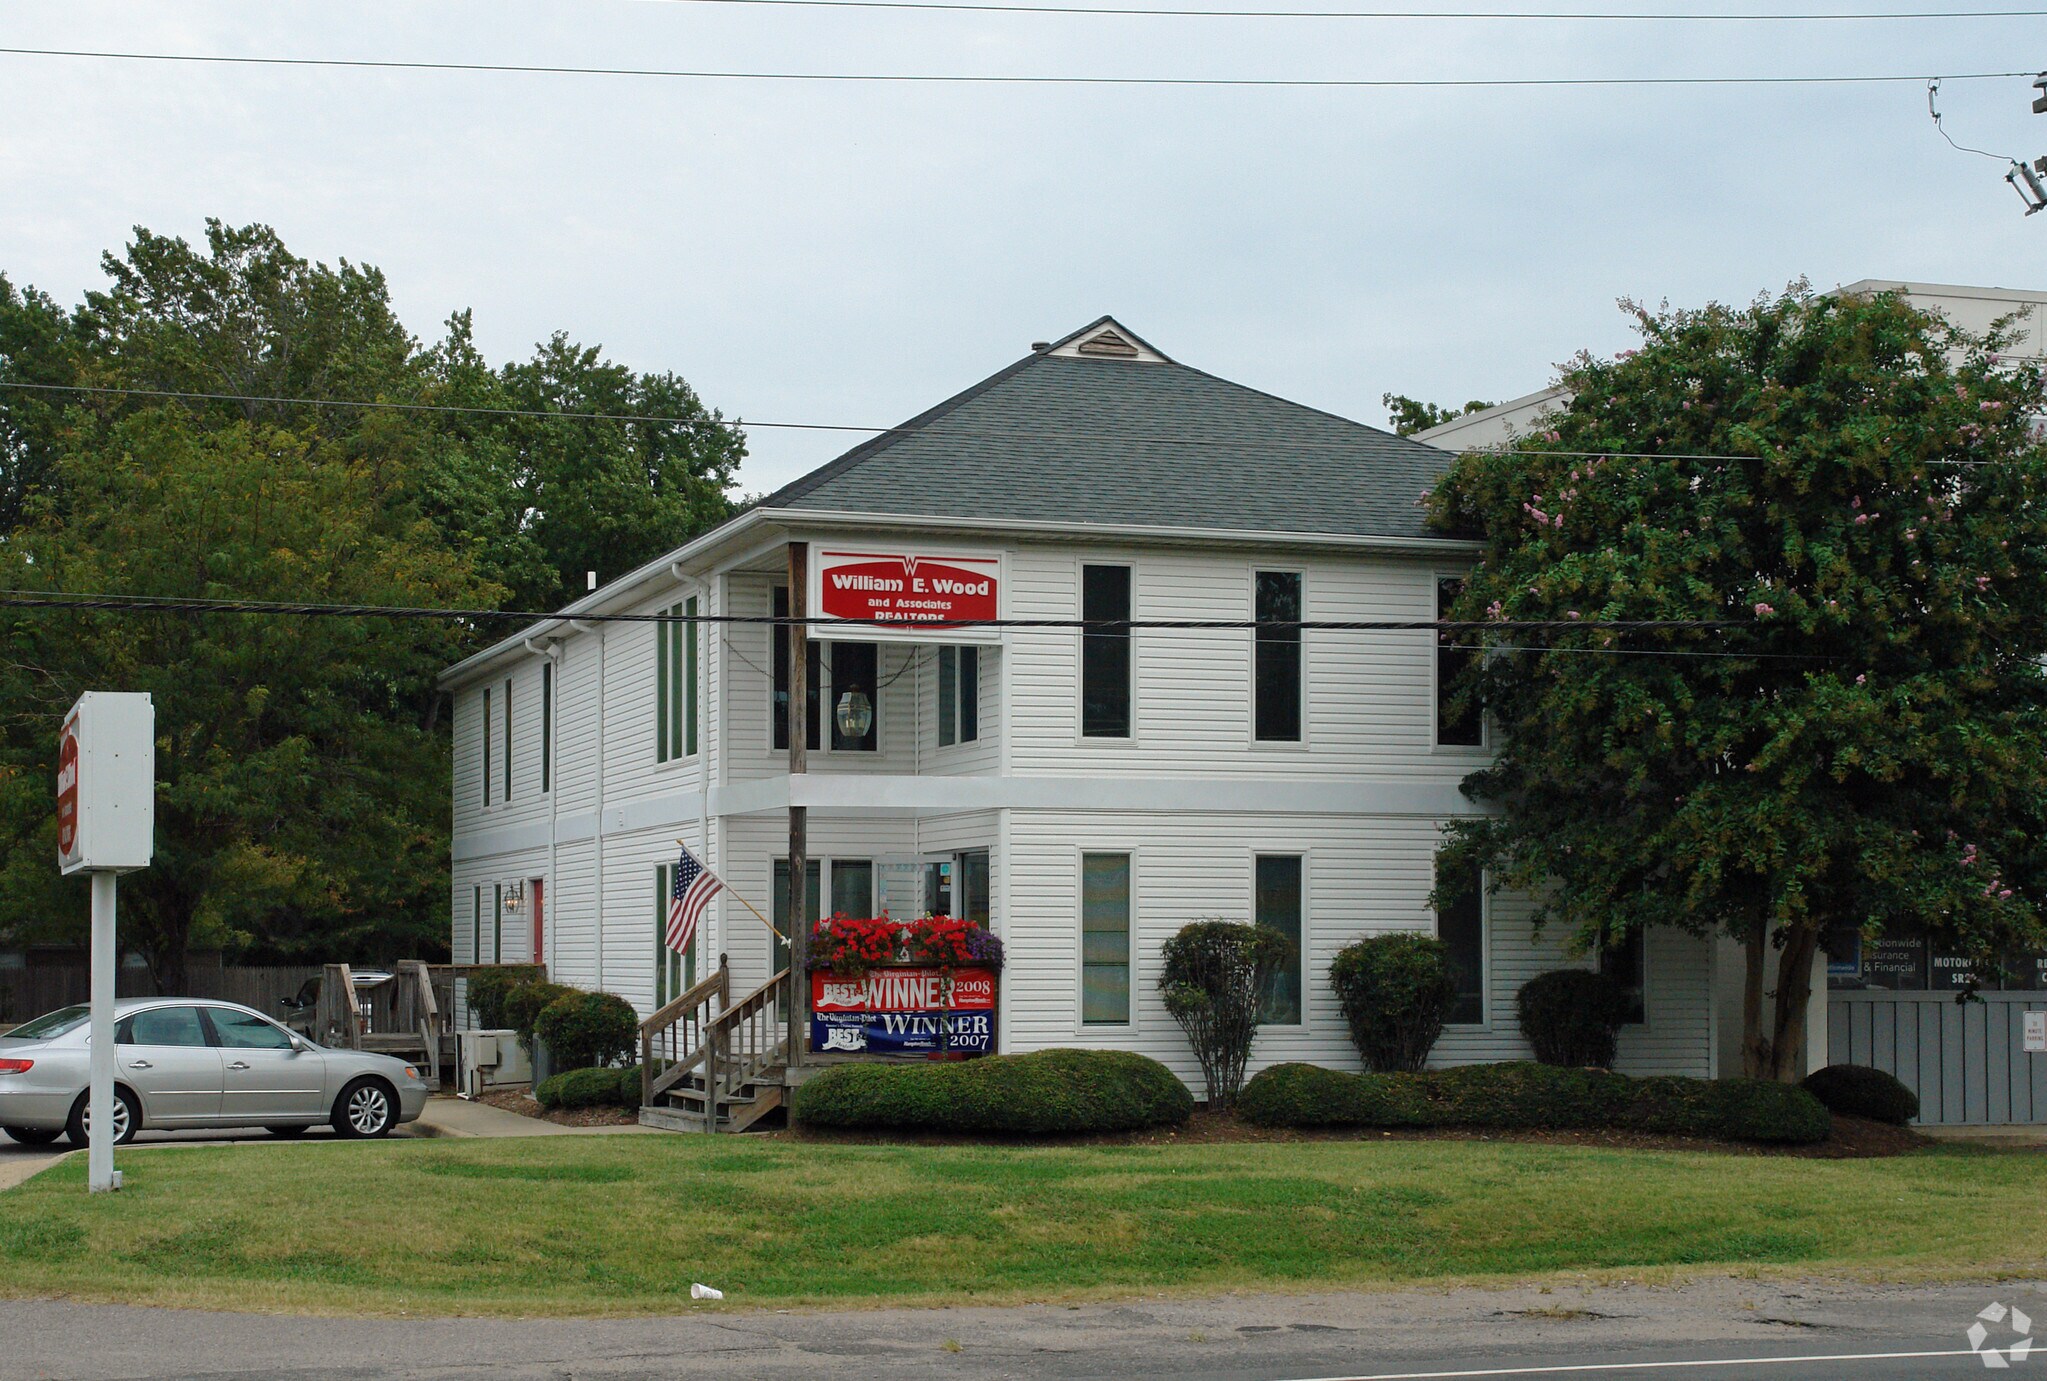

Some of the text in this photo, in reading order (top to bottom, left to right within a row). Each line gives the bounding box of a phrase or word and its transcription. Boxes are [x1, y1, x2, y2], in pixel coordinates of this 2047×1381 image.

[832, 574, 989, 596] William E. Wood
[868, 598, 952, 610] and Associates
[1863, 961, 1916, 972] & Financial
[823, 983, 858, 999] BEST
[861, 977, 956, 1010] WINNER
[956, 980, 991, 995] 2008
[816, 1012, 829, 1022] The
[881, 1014, 989, 1035] WINNER
[828, 1028, 860, 1043] BEST
[950, 1035, 989, 1050] 2007
